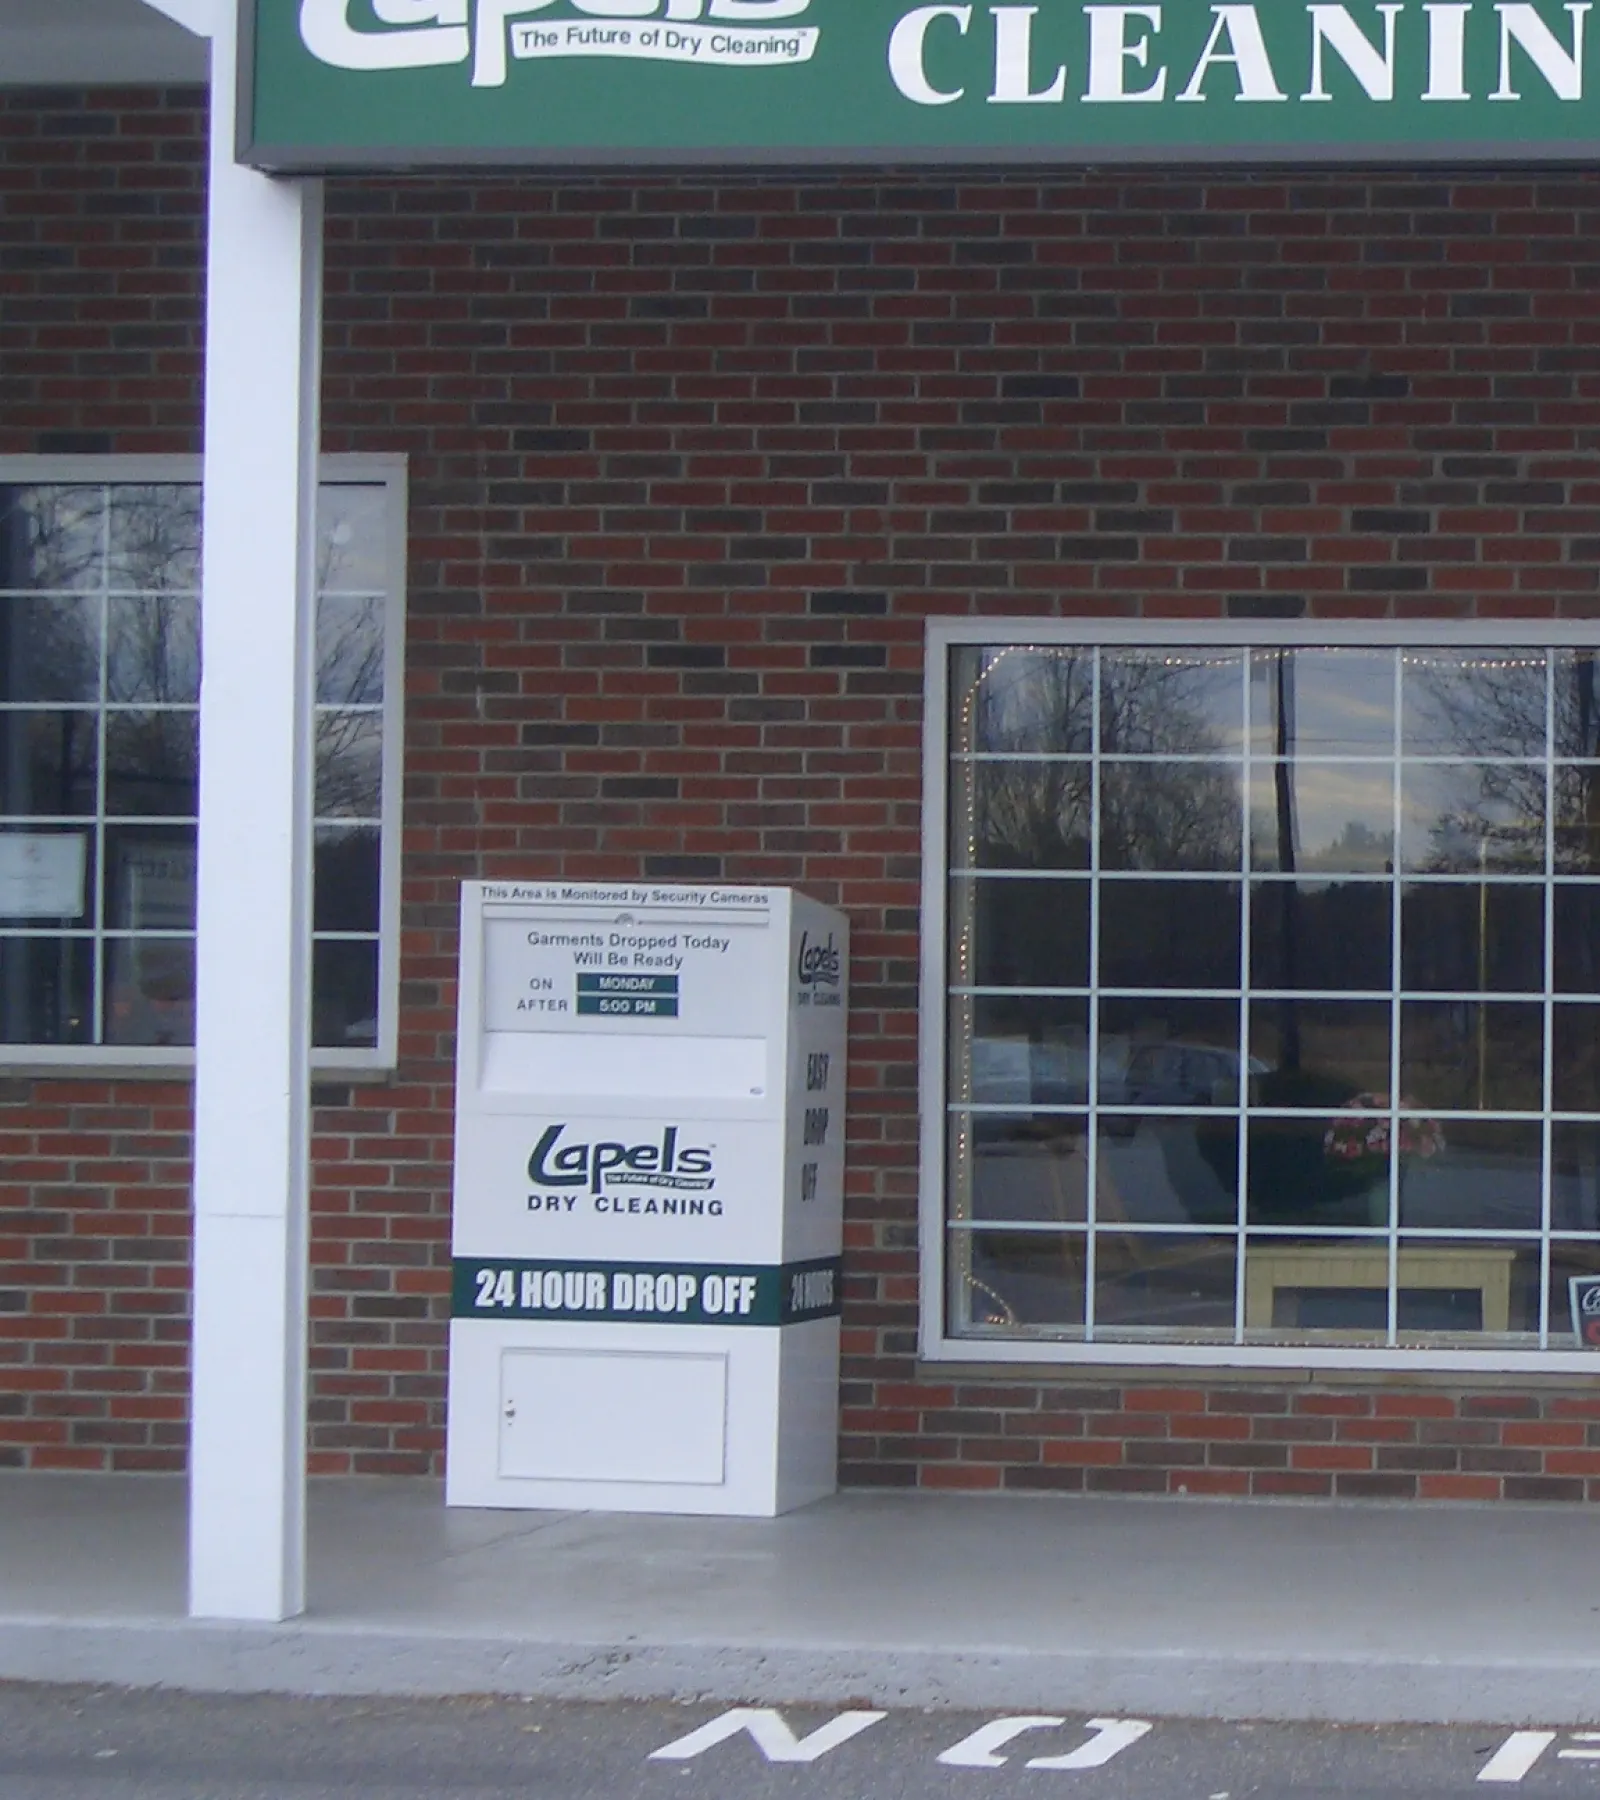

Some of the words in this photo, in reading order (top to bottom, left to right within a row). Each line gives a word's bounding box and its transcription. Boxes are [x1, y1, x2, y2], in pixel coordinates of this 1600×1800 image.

[520, 31, 558, 48] The
[565, 28, 631, 45] Future
[639, 30, 660, 45] of
[666, 31, 703, 55] Dry
[711, 35, 800, 56] Cleaning
[481, 886, 508, 899] This
[511, 888, 542, 900] Area
[546, 889, 557, 900] is
[561, 889, 627, 902] Monitored
[632, 889, 648, 903] by
[652, 890, 706, 905] Security
[710, 891, 769, 905] Cameras
[527, 932, 603, 947] Garments
[609, 934, 677, 950] Dropped
[682, 935, 730, 952] Today
[573, 952, 602, 966] Will
[608, 953, 629, 966] Be
[634, 954, 683, 970] Ready
[530, 978, 553, 990] ON
[599, 978, 656, 991] MONDAY
[516, 999, 568, 1012] AFTER
[635, 1001, 656, 1014] PM
[528, 1123, 712, 1194] Lapels
[528, 1195, 577, 1211] DRY
[594, 1196, 723, 1216] CLEANING
[475, 1269, 515, 1308] 24
[520, 1270, 606, 1310] HOUR
[612, 1273, 697, 1312] DROP
[702, 1275, 757, 1314] OFF
[647, 1707, 1154, 1769] NO
